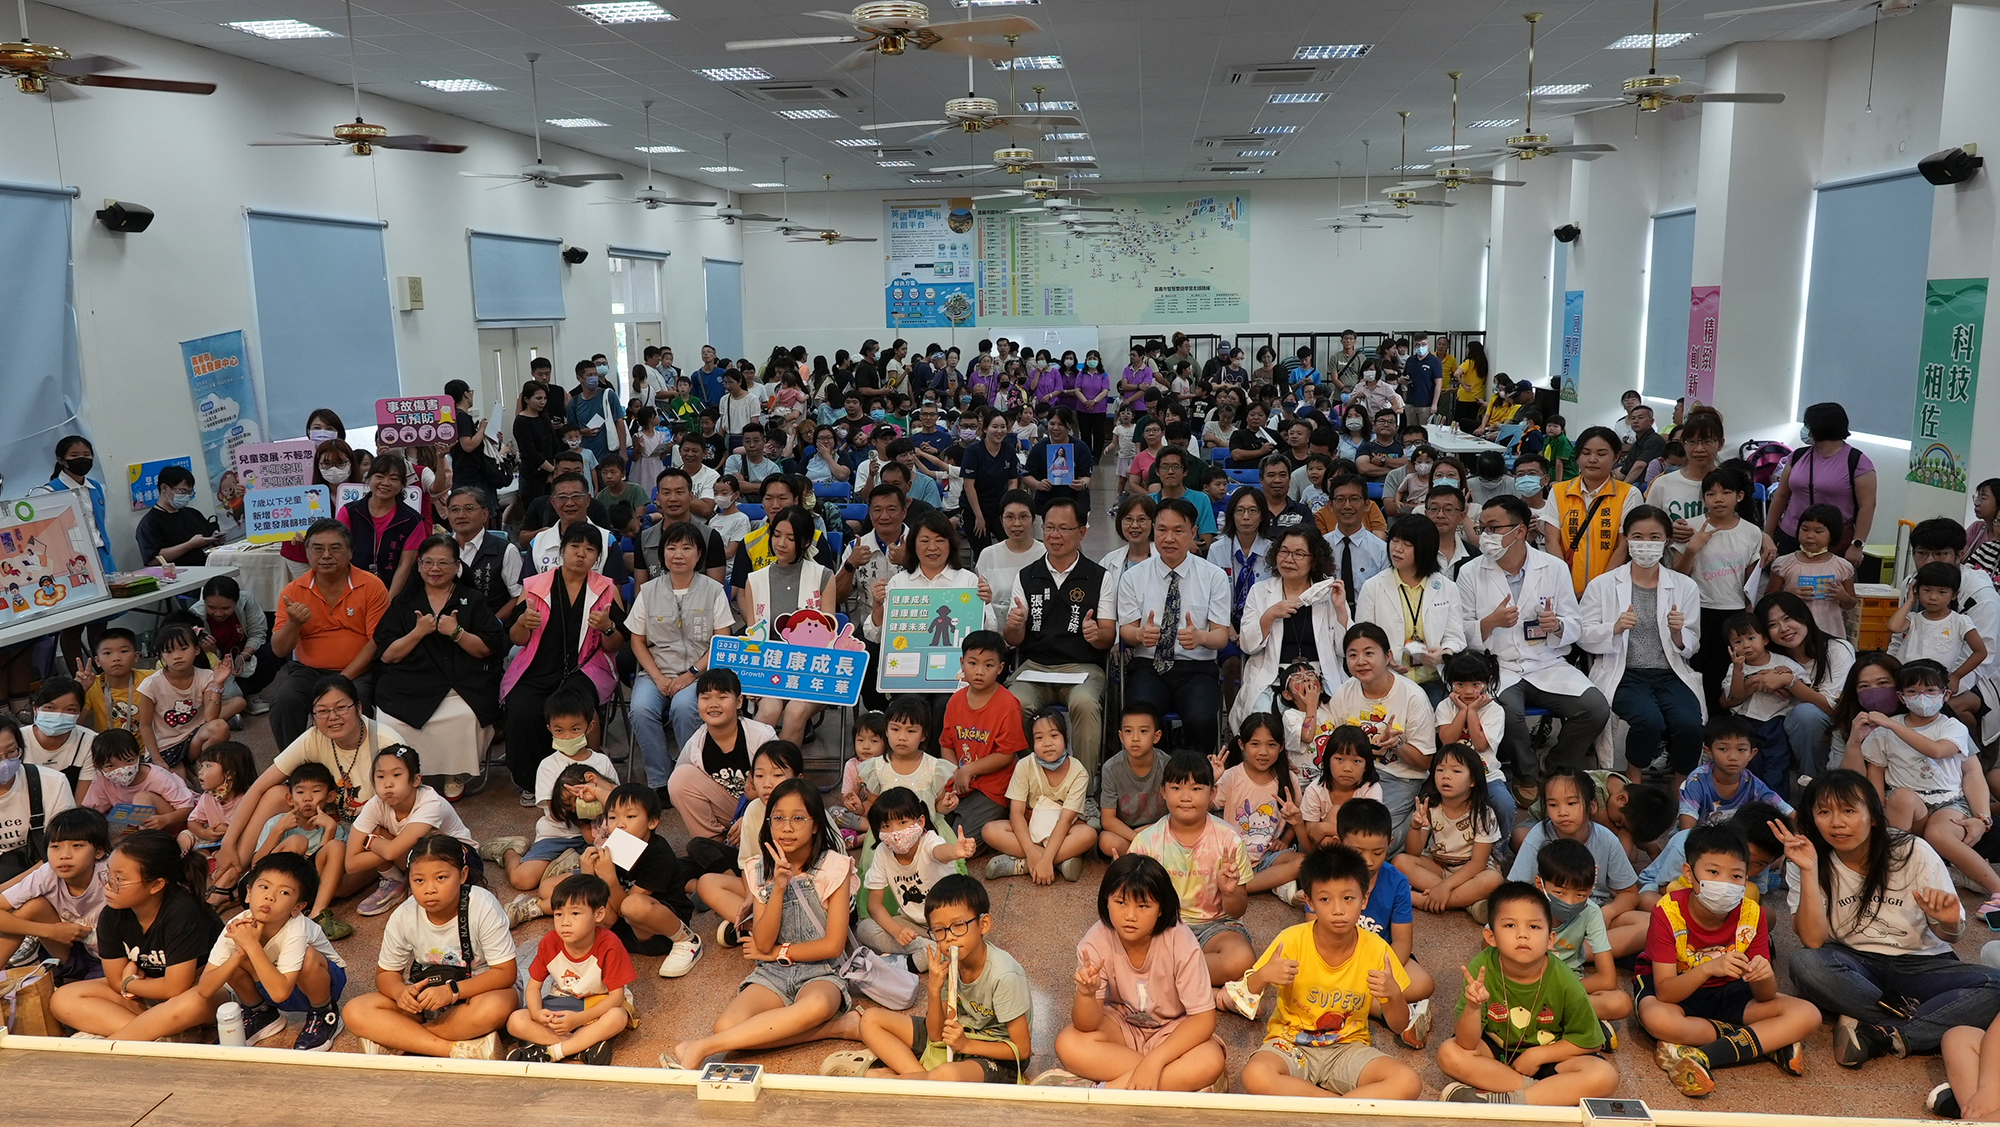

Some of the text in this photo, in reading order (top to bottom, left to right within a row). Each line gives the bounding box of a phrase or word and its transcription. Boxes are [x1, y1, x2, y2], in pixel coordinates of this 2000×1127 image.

[891, 208, 942, 221] 英語智慧城市
[892, 220, 925, 230] 共創平台
[1701, 317, 1716, 372] 精緻
[1947, 323, 1976, 404] 科技
[1688, 345, 1701, 398] 創新
[386, 399, 439, 413] 事故傷害
[1919, 362, 1946, 439] 相佐
[395, 412, 435, 425] 可預防
[260, 462, 303, 476] 早期發現
[251, 496, 302, 508] 7歲以下兒童
[252, 507, 292, 520] 新增6次
[1601, 508, 1611, 551] 服務團隊
[892, 595, 931, 605] 健康成長
[891, 608, 929, 618] 健康體位
[1067, 604, 1081, 634] 立法院
[889, 622, 928, 632] 健康未來
[718, 641, 739, 650] 2026
[715, 651, 761, 666] 世界兒童
[762, 648, 855, 677] 健康成長
[740, 669, 766, 679] Growth
[784, 674, 850, 695] 嘉年華
[1837, 895, 1857, 908] HOT
